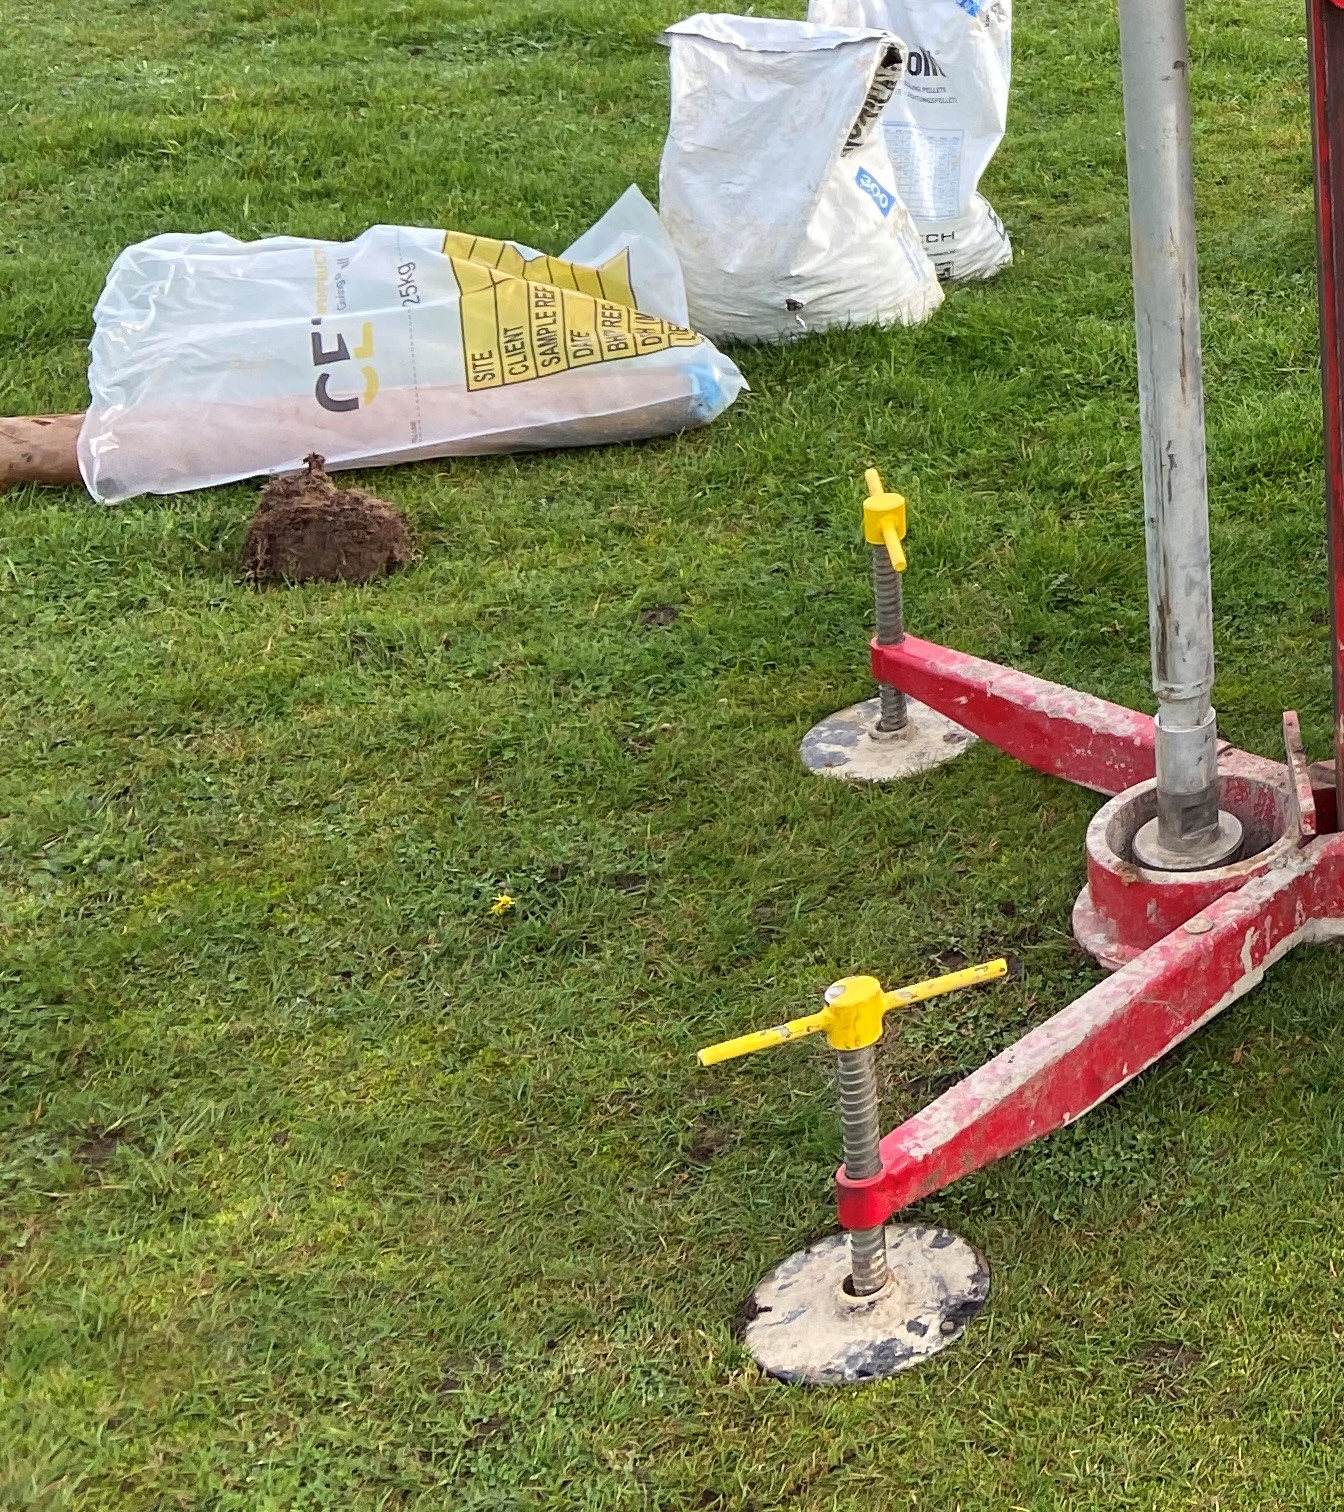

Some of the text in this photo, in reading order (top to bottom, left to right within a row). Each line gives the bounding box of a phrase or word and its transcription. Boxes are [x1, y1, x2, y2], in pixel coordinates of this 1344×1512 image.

[859, 174, 889, 208] 300
[397, 262, 420, 307] 25kg
[534, 285, 561, 368] SAMPLE REF
[601, 303, 622, 328] REF
[503, 325, 530, 377] CLIENT
[569, 329, 594, 360] DATE
[472, 349, 496, 382] SITE
